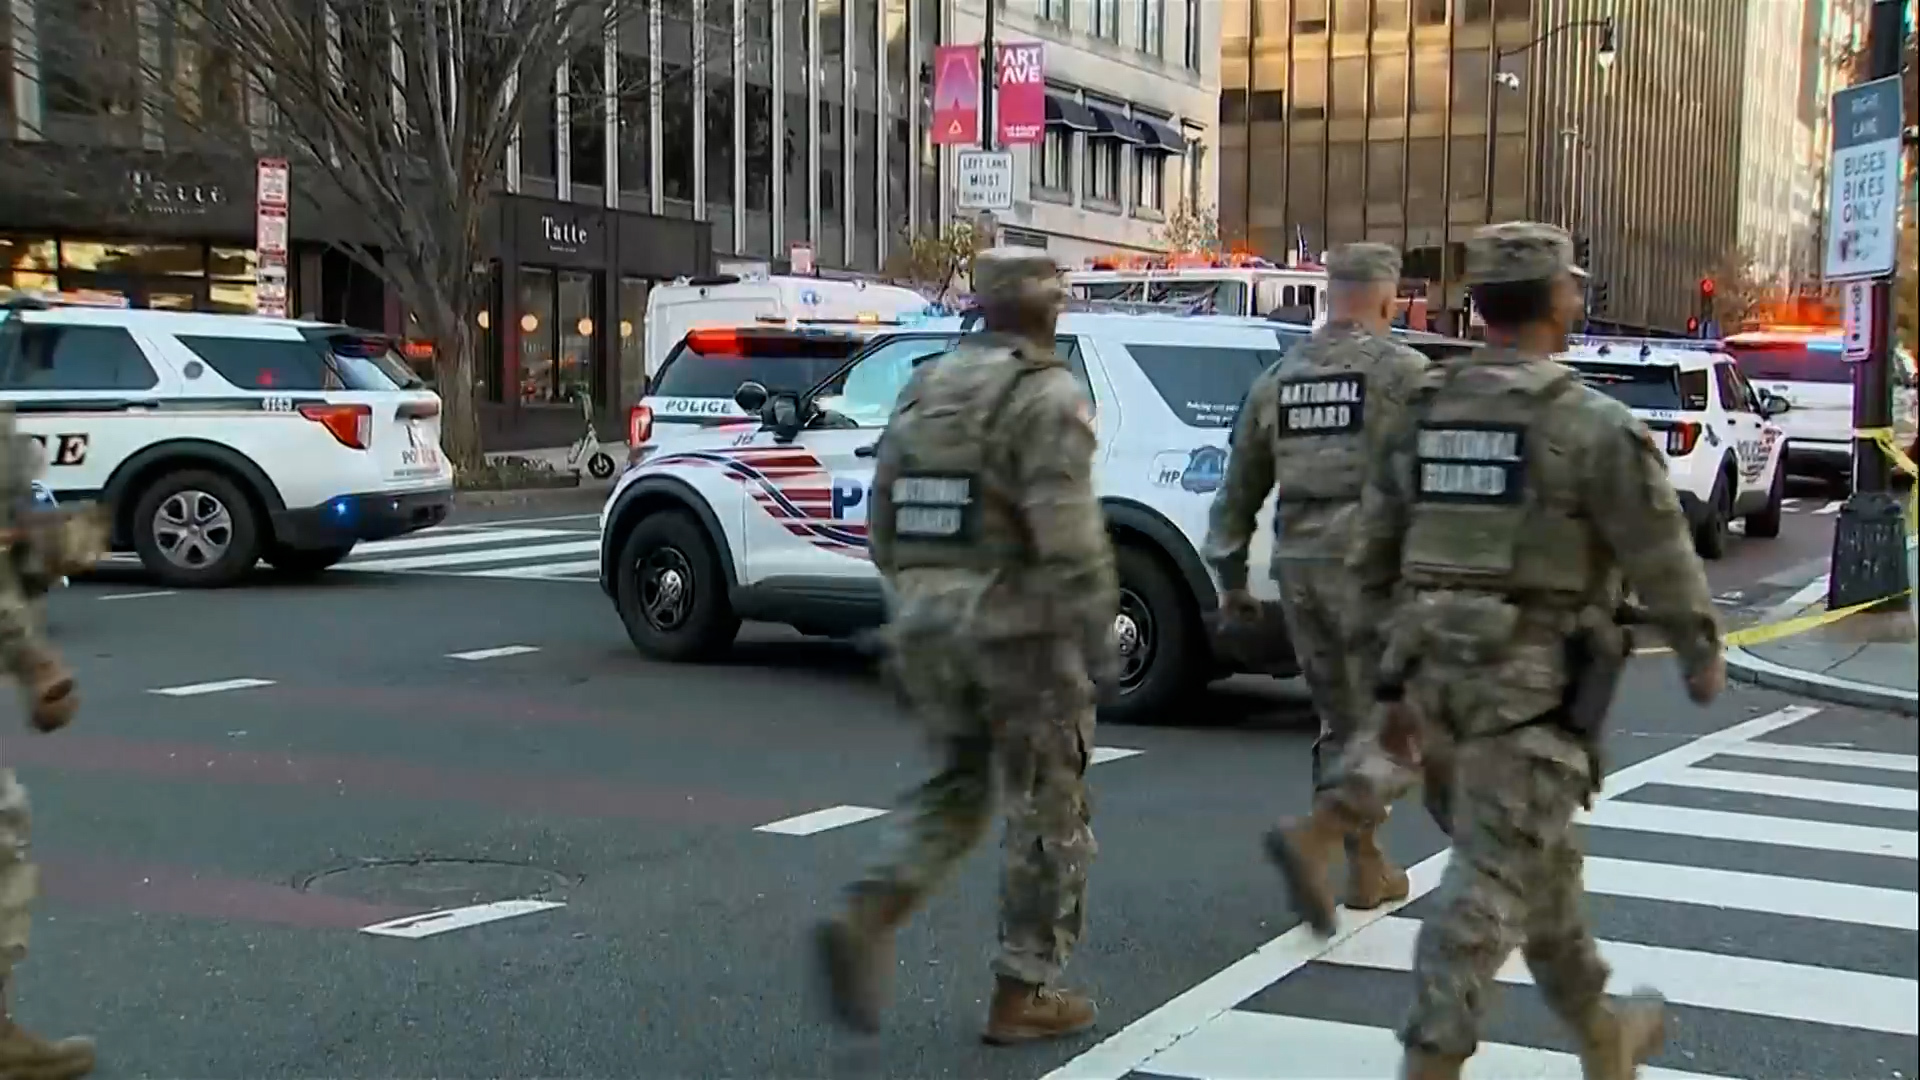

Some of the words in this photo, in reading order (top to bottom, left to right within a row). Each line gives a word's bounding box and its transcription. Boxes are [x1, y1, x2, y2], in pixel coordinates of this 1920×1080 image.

[1002, 48, 1040, 67] ART
[1002, 66, 1040, 84] AVE
[963, 157, 983, 169] LEFT
[986, 157, 1008, 169] LANE
[1843, 150, 1886, 177] BUSES
[970, 173, 999, 187] MUST
[1843, 175, 1885, 201] BIKES
[987, 190, 1007, 205] LEFT
[1843, 200, 1882, 223] ONLY
[541, 215, 588, 244] Tatte
[1280, 380, 1361, 404] NATIONAL
[665, 400, 732, 414] POLICE
[1288, 404, 1350, 429] GUARD
